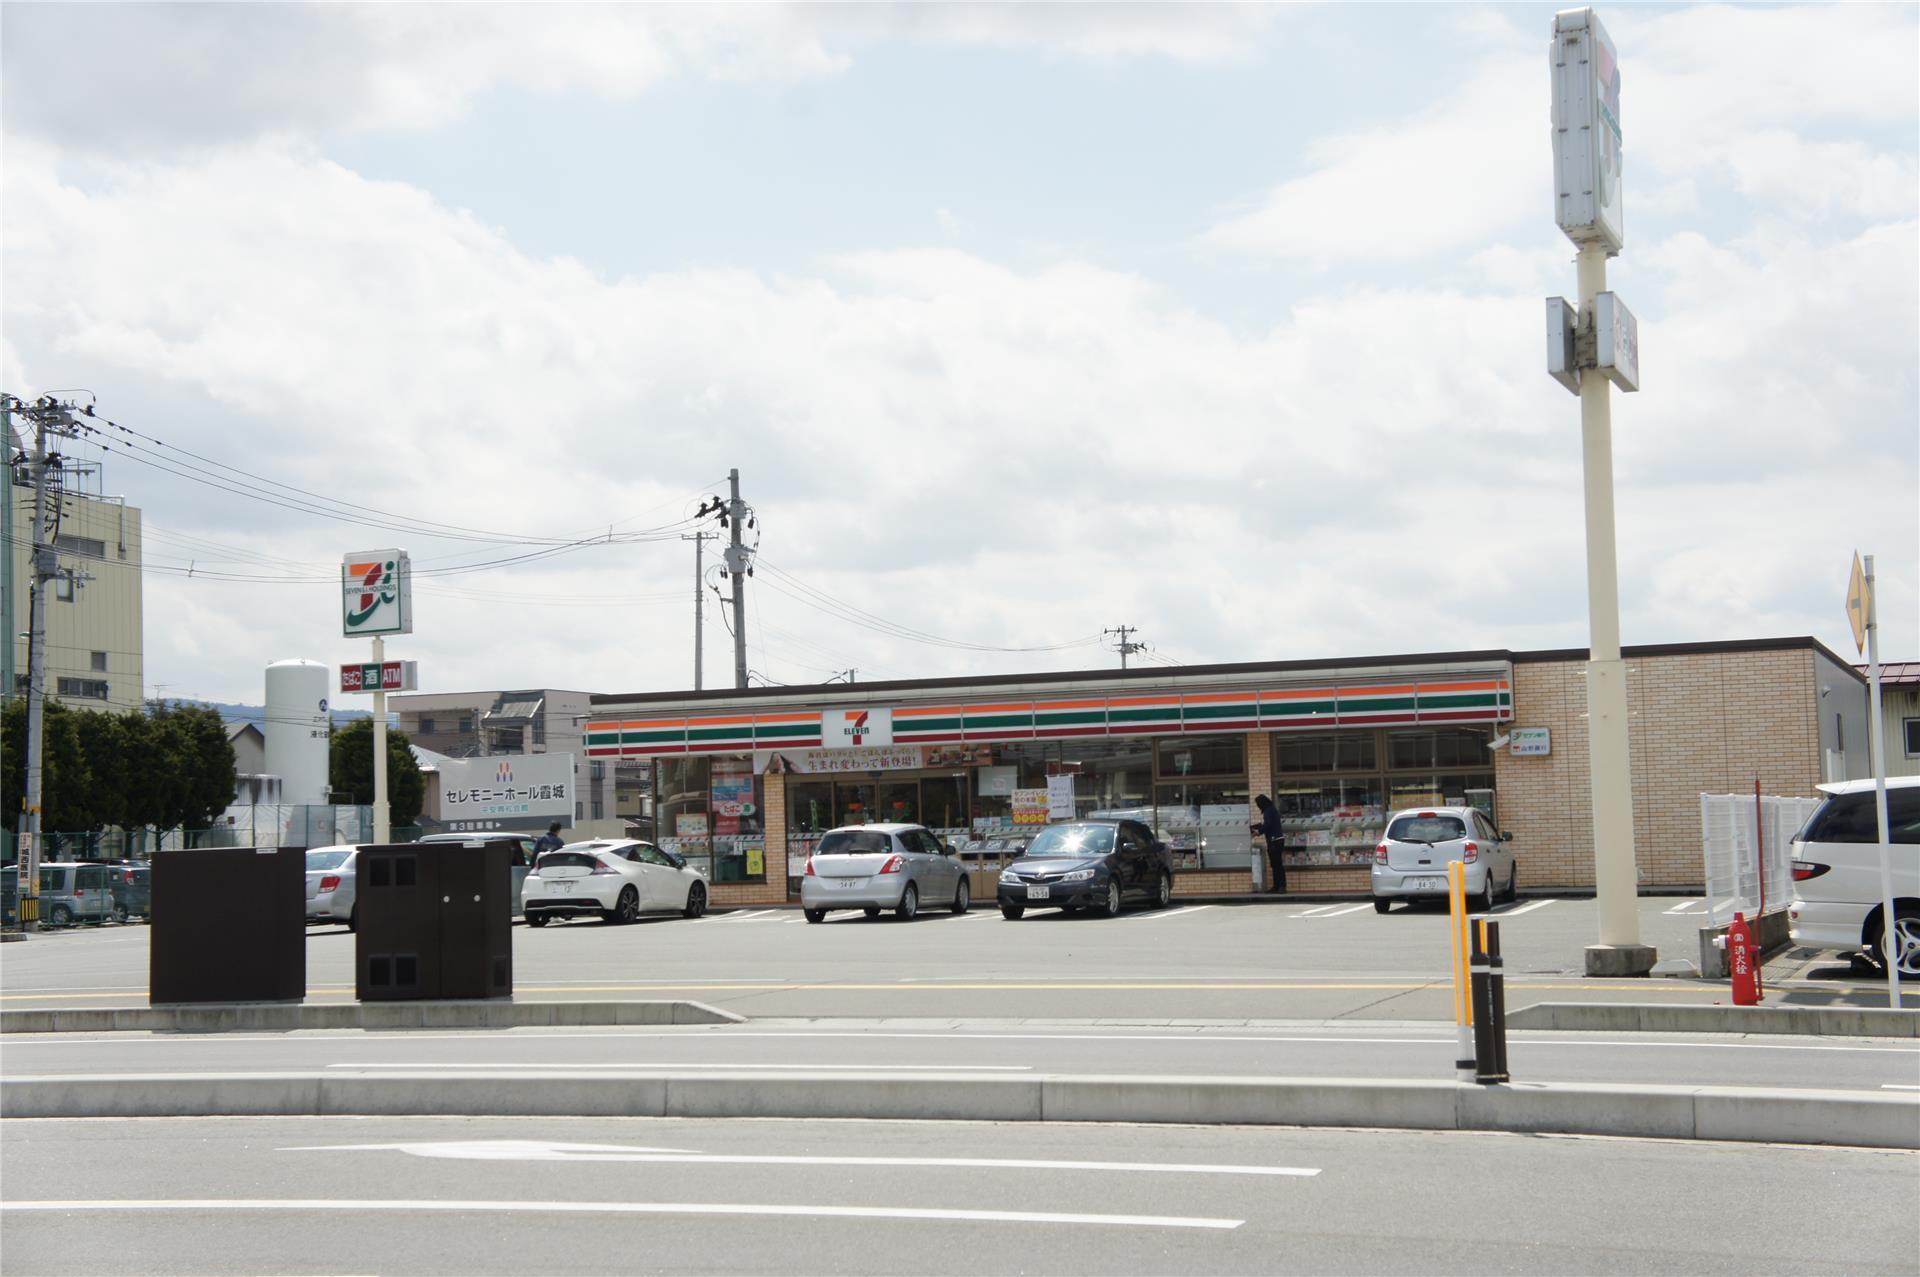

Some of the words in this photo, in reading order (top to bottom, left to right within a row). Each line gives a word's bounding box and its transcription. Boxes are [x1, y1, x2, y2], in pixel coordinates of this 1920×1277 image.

[342, 670, 361, 686] たばこ
[365, 669, 378, 685] 酒
[382, 668, 401, 683] ATM
[446, 784, 564, 803] セレモニーホール霞城
[450, 821, 494, 831] 第3駐車場
[1735, 944, 1748, 975] 消火栓
